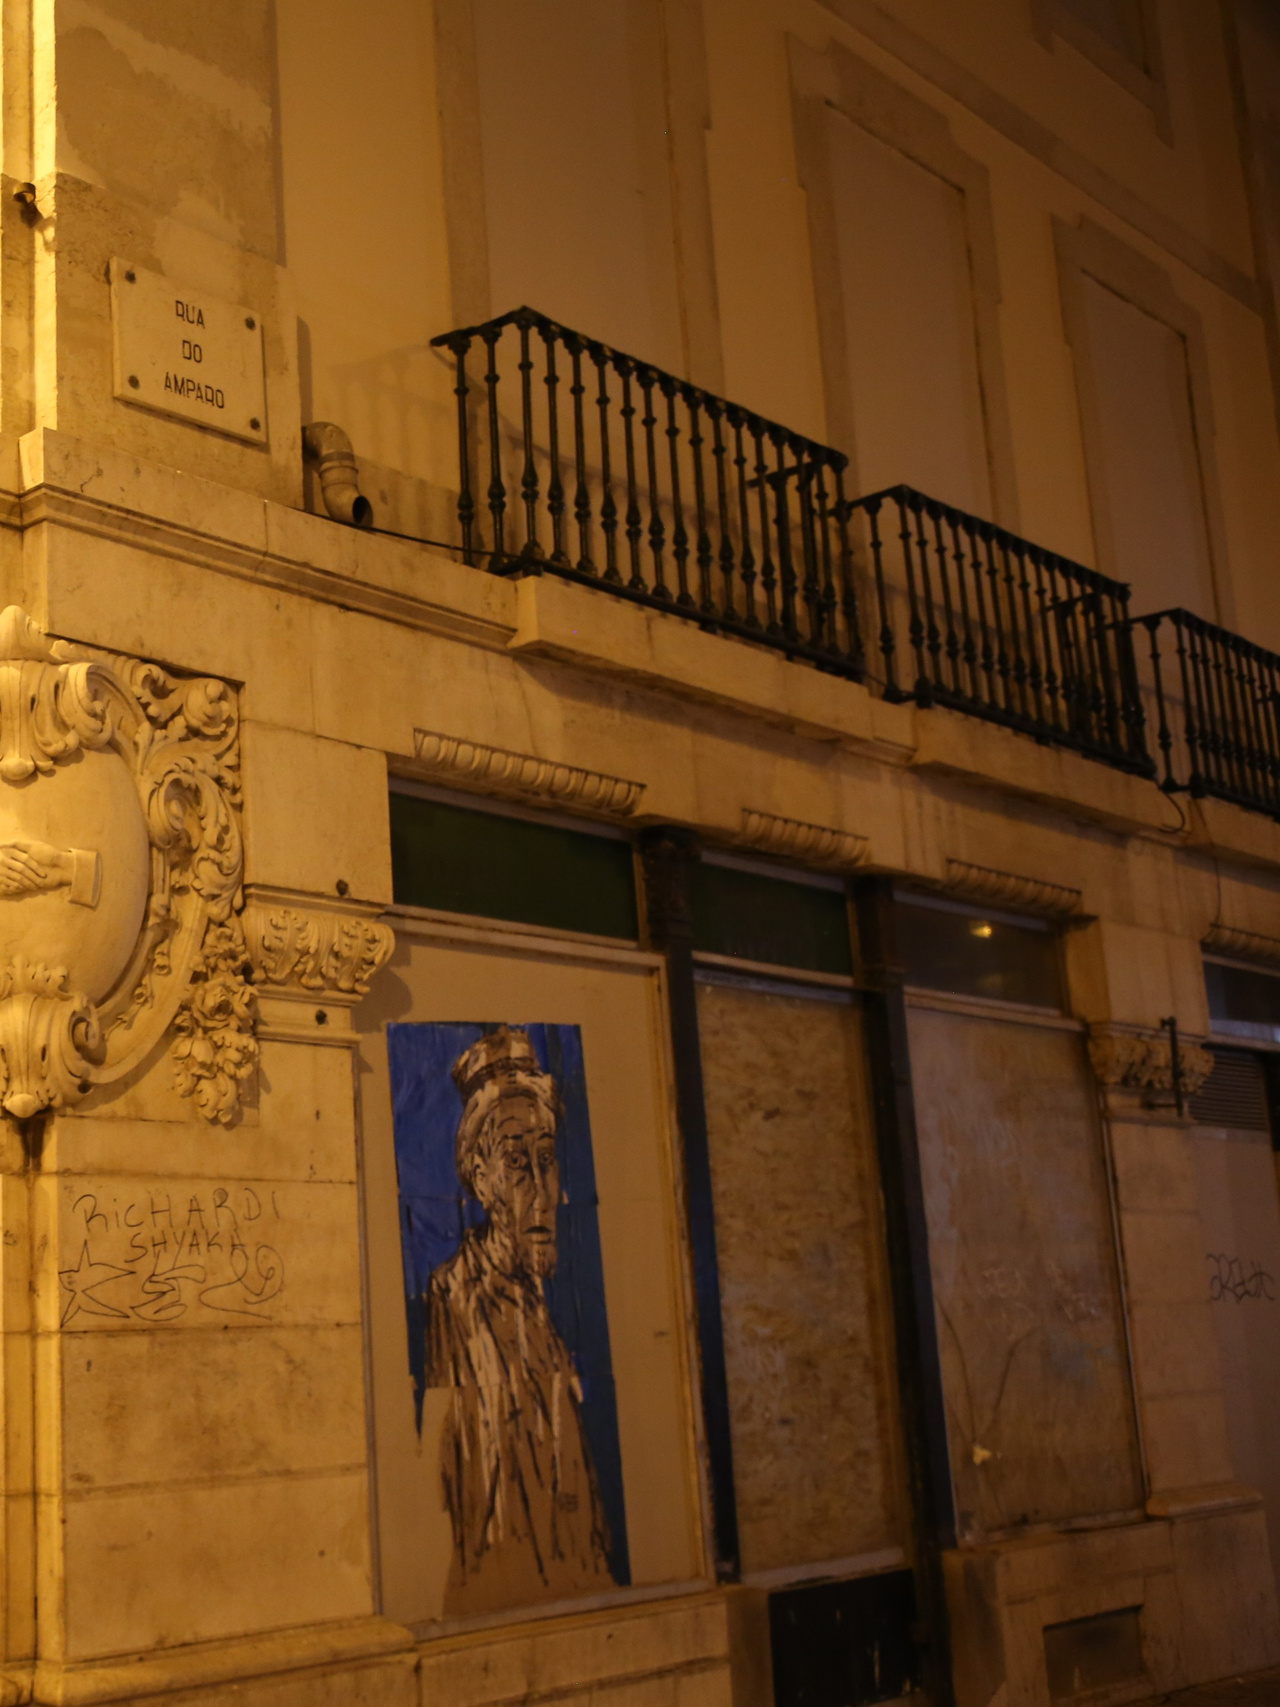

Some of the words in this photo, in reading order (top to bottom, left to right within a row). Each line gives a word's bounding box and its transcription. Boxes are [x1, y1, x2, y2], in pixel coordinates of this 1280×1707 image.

[175, 300, 206, 330] RUA
[182, 339, 203, 364] DO
[163, 371, 226, 410] AMPARO
